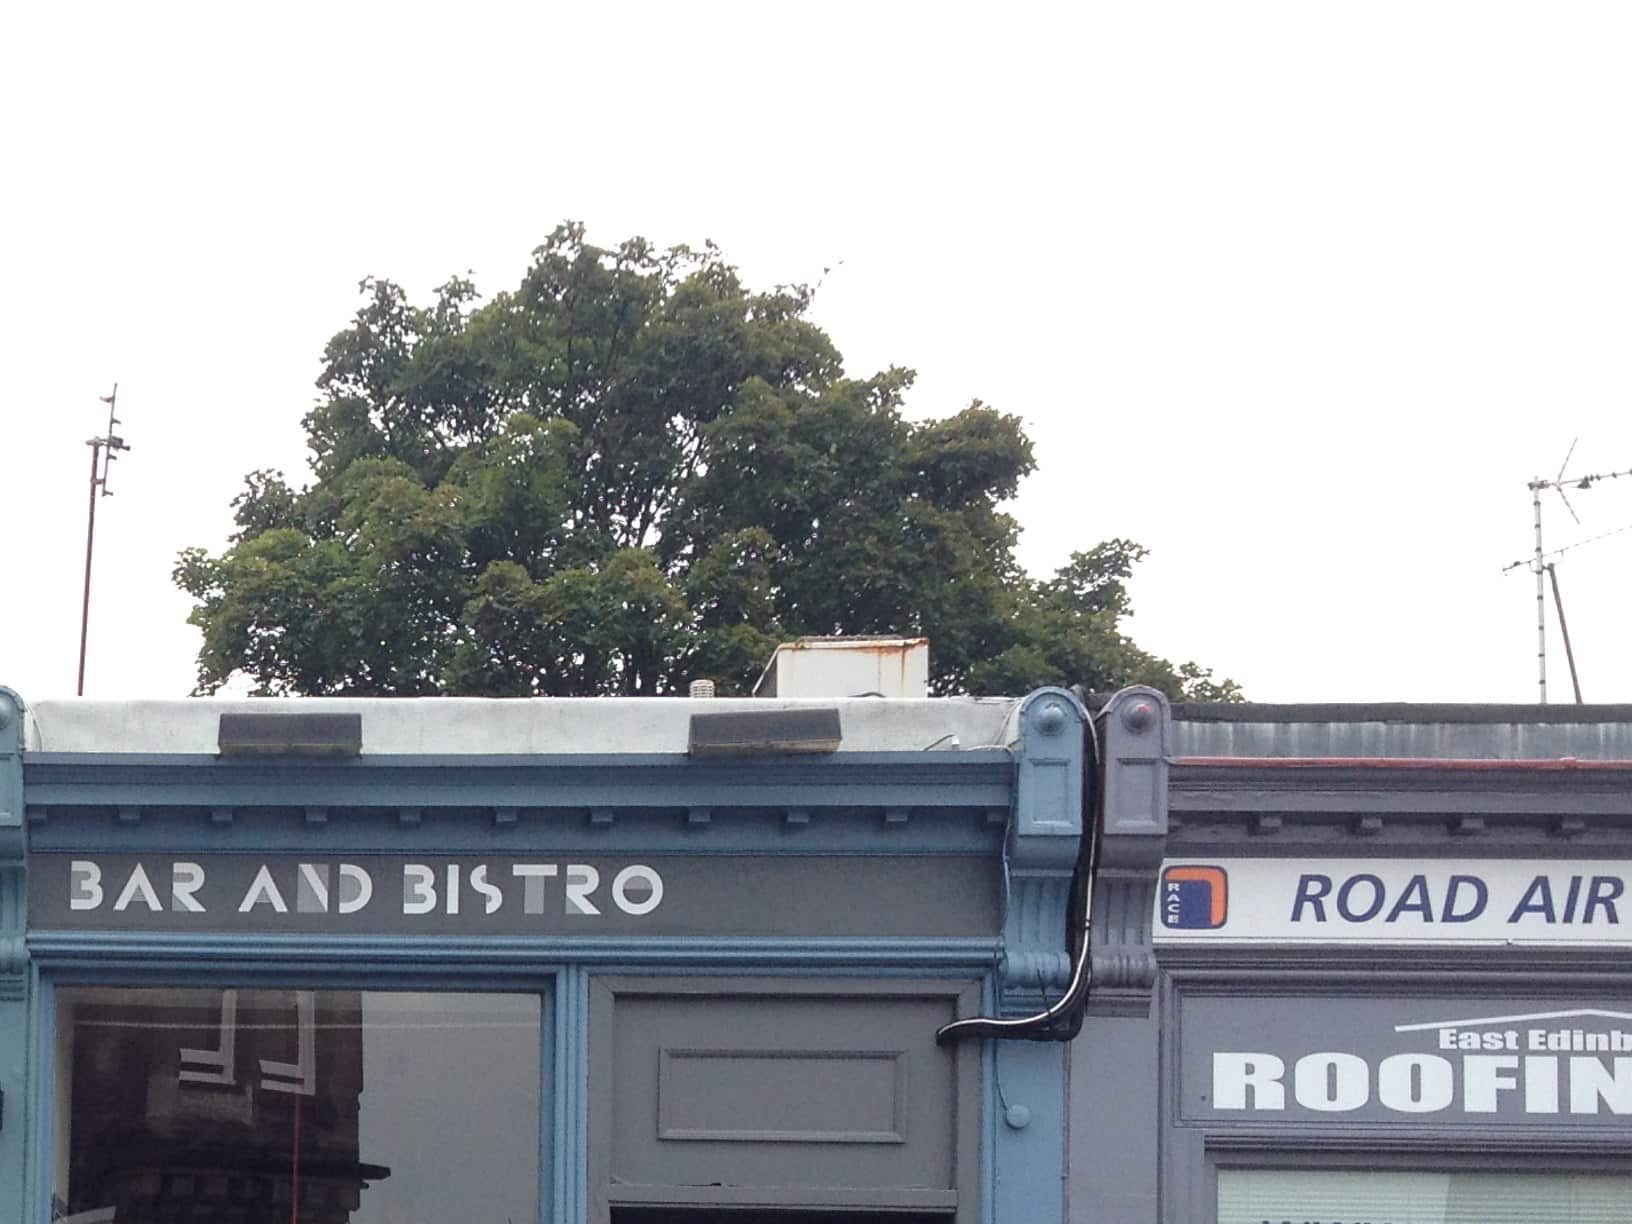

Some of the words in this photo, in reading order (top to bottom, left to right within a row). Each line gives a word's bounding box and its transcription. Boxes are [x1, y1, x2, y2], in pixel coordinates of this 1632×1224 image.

[70, 861, 206, 912] BAR
[238, 864, 372, 914] AND
[403, 863, 663, 915] BISTRO
[1168, 883, 1180, 924] RACE
[1290, 873, 1489, 924] ROAD
[1507, 875, 1625, 925] AIR
[1439, 1028, 1519, 1050] East
[1528, 1029, 1632, 1051] Edinb
[1213, 1052, 1632, 1114] ROOFIN
